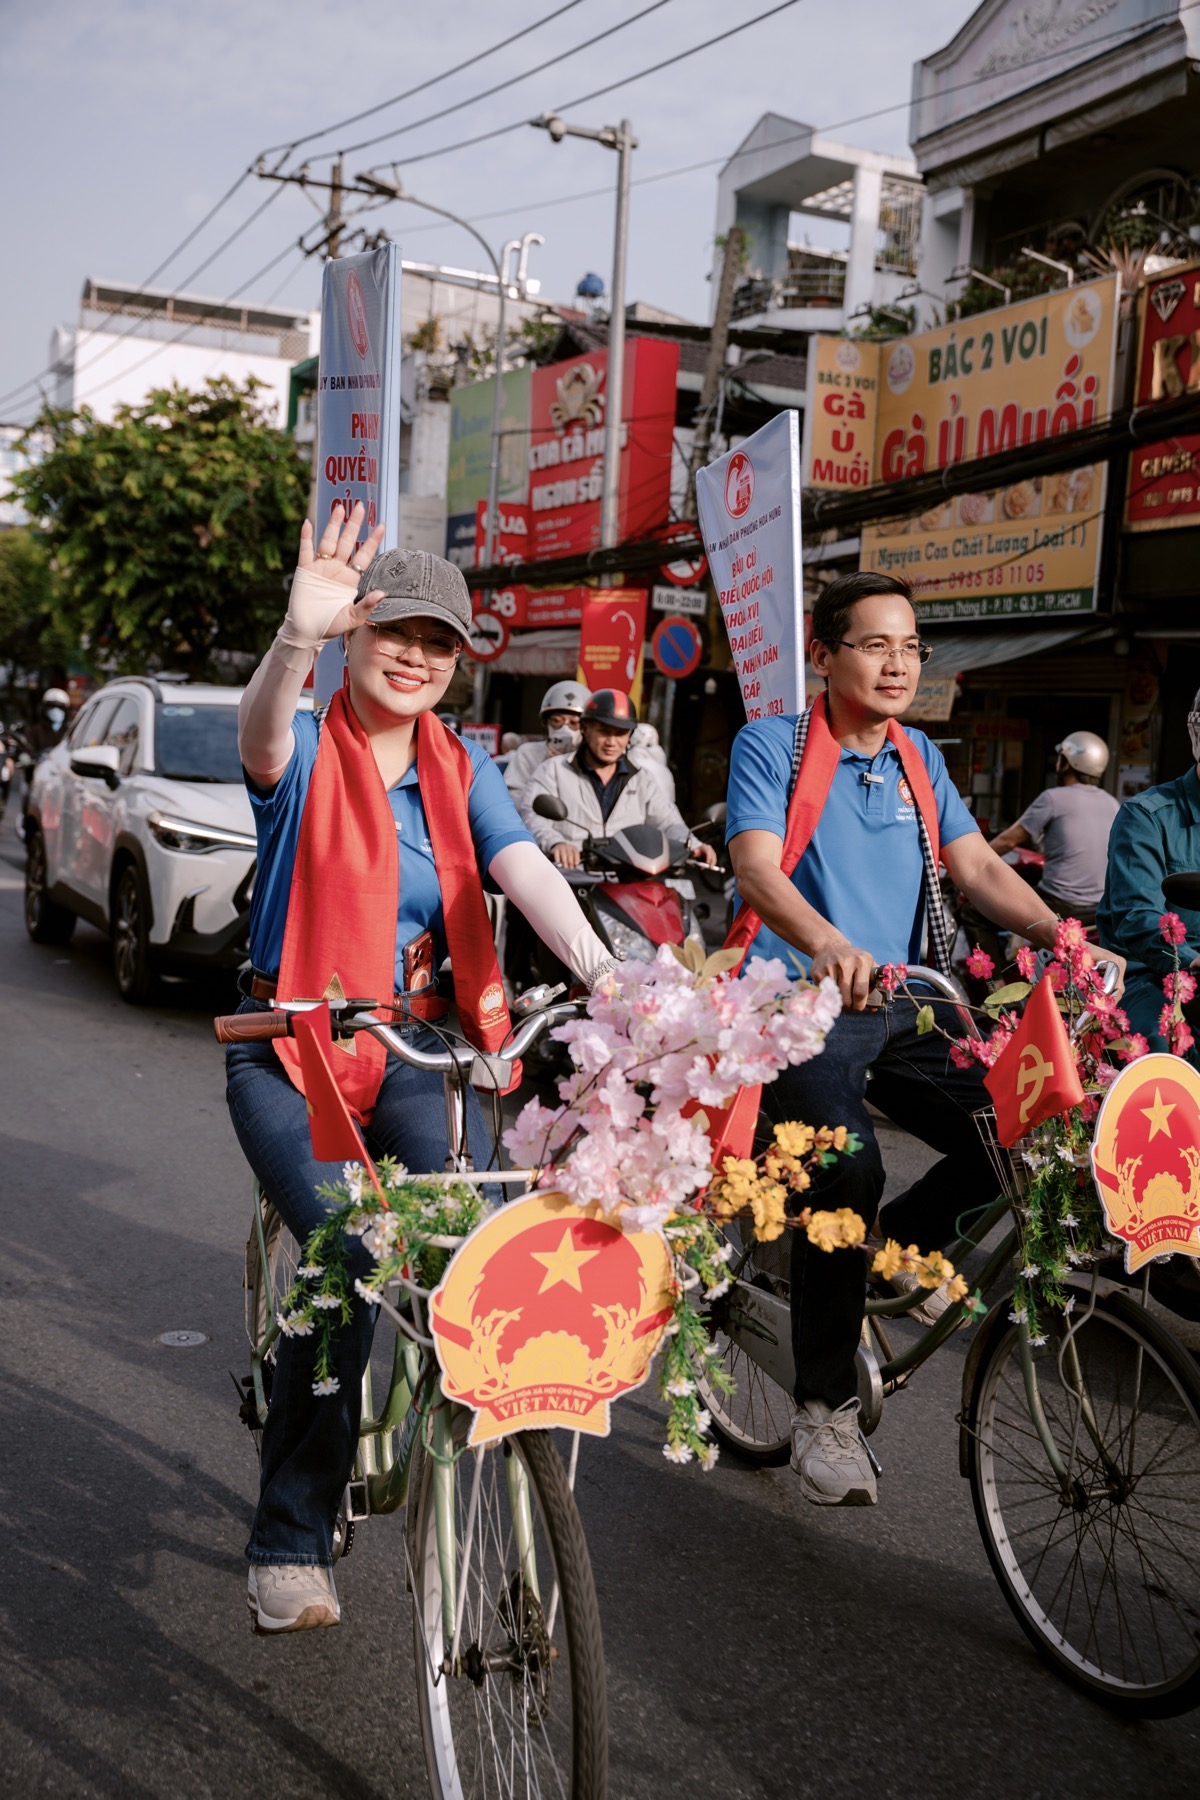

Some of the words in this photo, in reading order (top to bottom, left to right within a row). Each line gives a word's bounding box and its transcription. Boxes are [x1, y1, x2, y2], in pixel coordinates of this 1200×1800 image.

[928, 332, 975, 384] BÁC
[981, 332, 994, 371] 2
[1002, 316, 1048, 365] VOI
[330, 375, 345, 390] BAN
[818, 370, 841, 387] BÁC
[845, 376, 851, 387] 2
[854, 377, 876, 391] VOI
[823, 392, 866, 419] Gà
[881, 413, 927, 484] Gà
[977, 354, 1097, 460] Muối
[813, 452, 869, 486] Muối
[925, 541, 949, 562] Con
[952, 534, 983, 557] Chất
[987, 533, 1029, 557] Lượng
[741, 570, 760, 600] QUỐC
[762, 564, 774, 588] HỘI
[949, 569, 983, 590] 0986
[987, 567, 1004, 586] 88
[1010, 565, 1022, 584] 11
[1026, 563, 1045, 583] 05
[747, 601, 759, 621] XVI
[993, 597, 1011, 613] P.10
[1019, 595, 1037, 613] Q.3
[1044, 593, 1081, 609] TP.HCM
[731, 635, 748, 655] ĐẠI
[763, 643, 779, 666] DÂN
[743, 676, 761, 701] CẤP
[1140, 1229, 1163, 1248] VIỆT
[1166, 1228, 1187, 1239] NAM
[498, 1396, 544, 1419] VIỆT
[546, 1395, 588, 1415] NAM
